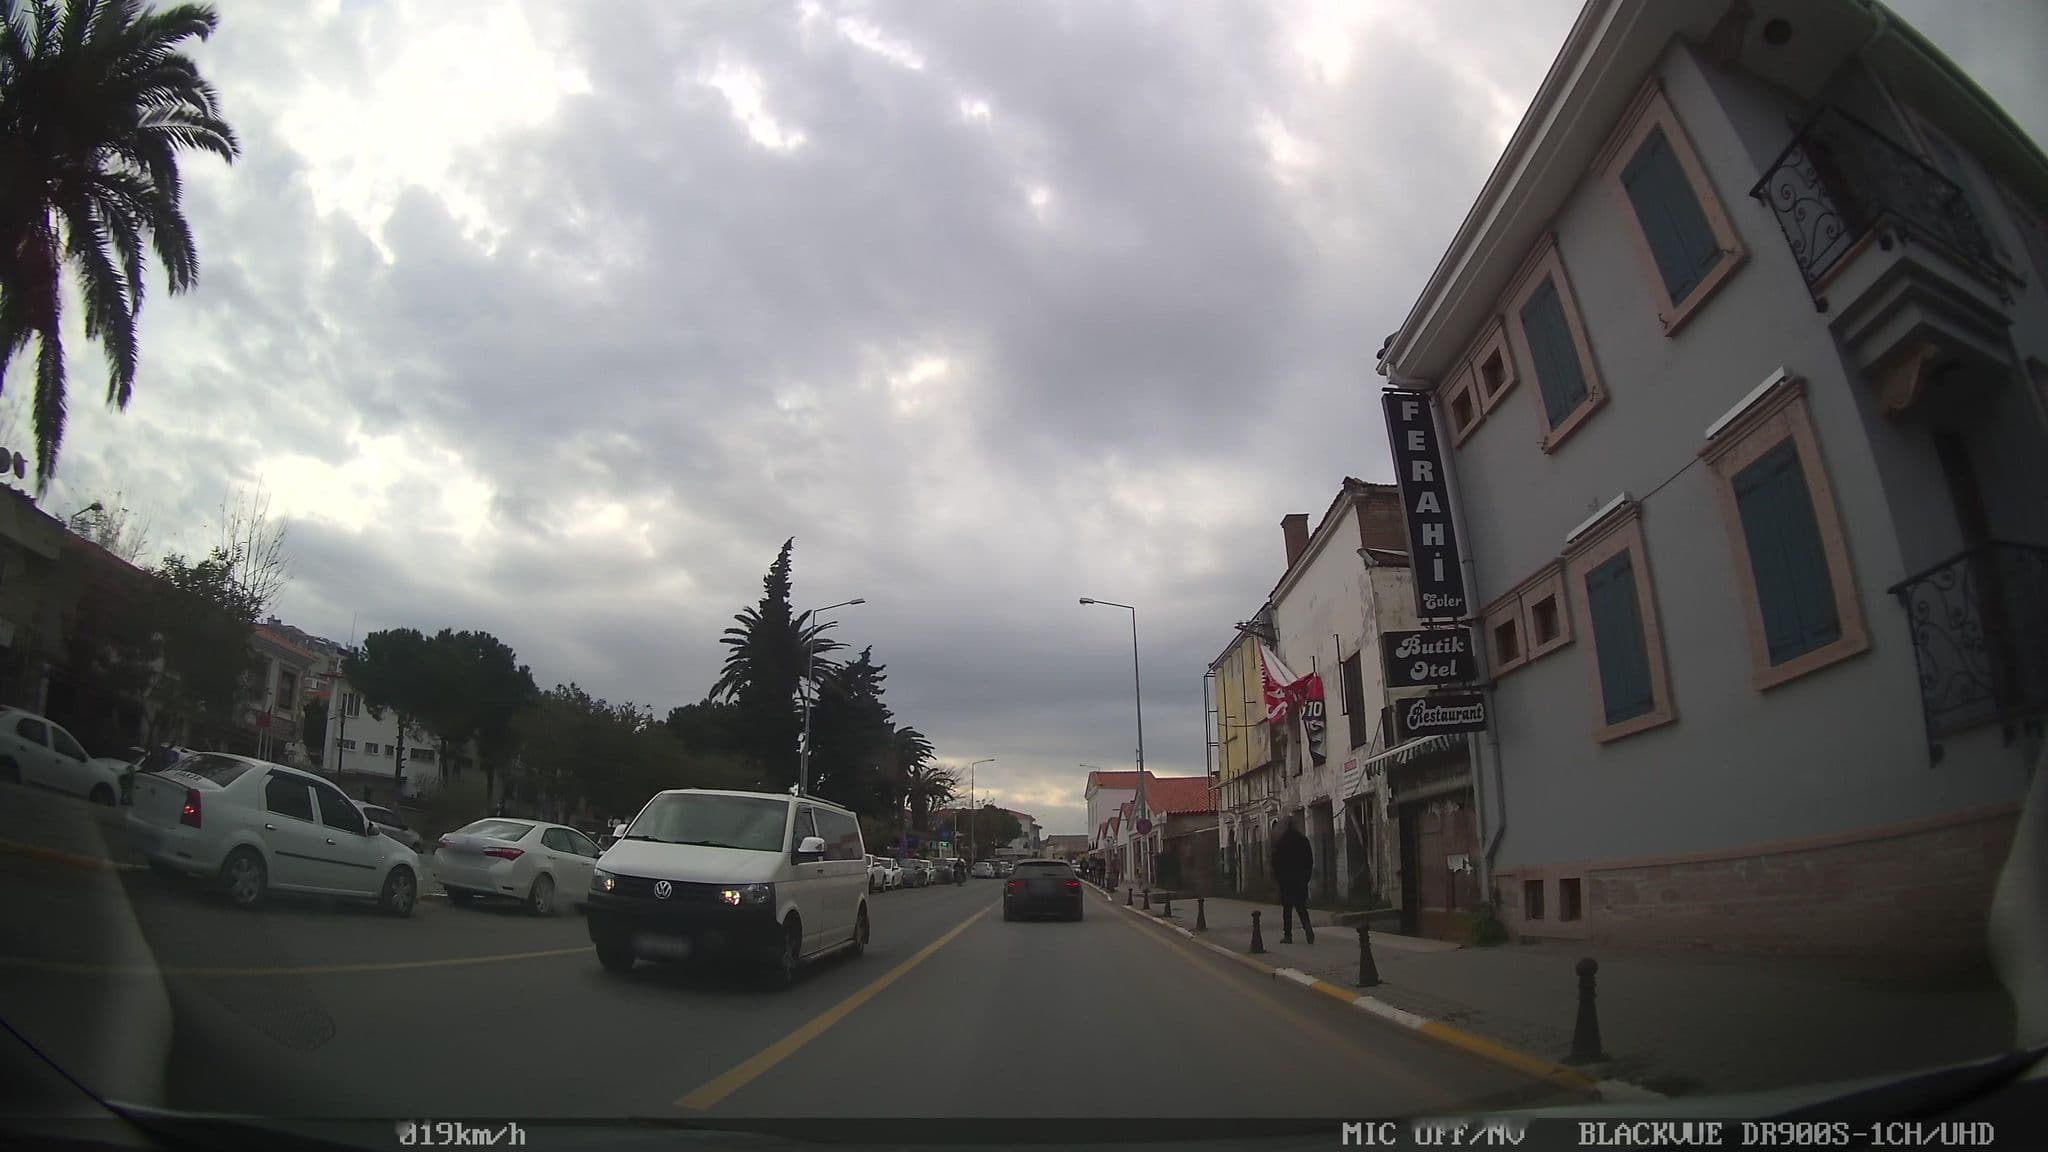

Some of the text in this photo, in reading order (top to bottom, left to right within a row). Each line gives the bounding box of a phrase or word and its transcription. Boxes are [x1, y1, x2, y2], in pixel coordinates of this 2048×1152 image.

[1423, 593, 1462, 610] Evler
[1395, 634, 1464, 658] Butik
[1410, 660, 1457, 680] Otel
[1407, 700, 1484, 730] Restaurant
